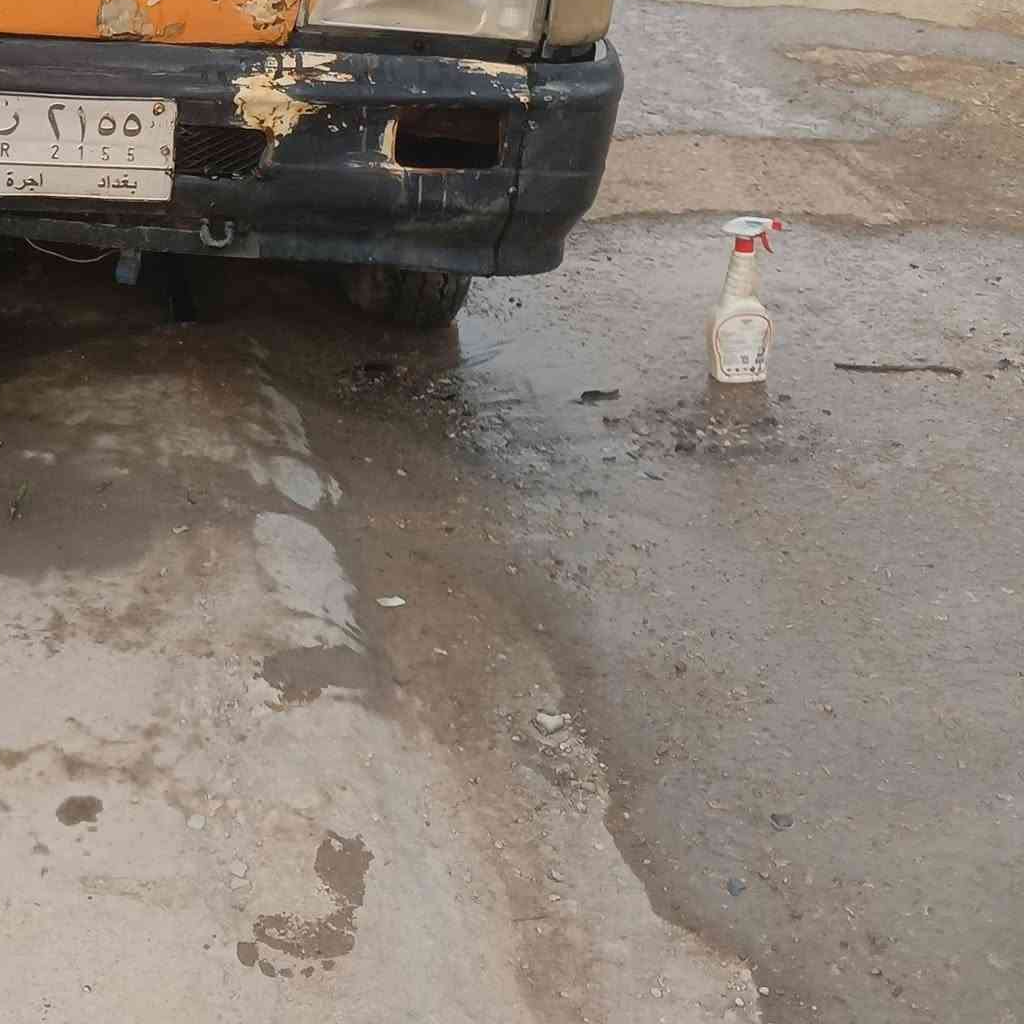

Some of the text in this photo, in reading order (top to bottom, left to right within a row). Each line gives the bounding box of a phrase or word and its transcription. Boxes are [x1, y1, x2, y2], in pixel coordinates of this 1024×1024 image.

[0, 143, 11, 159] R
[6, 172, 138, 194] بغداد اجرة
